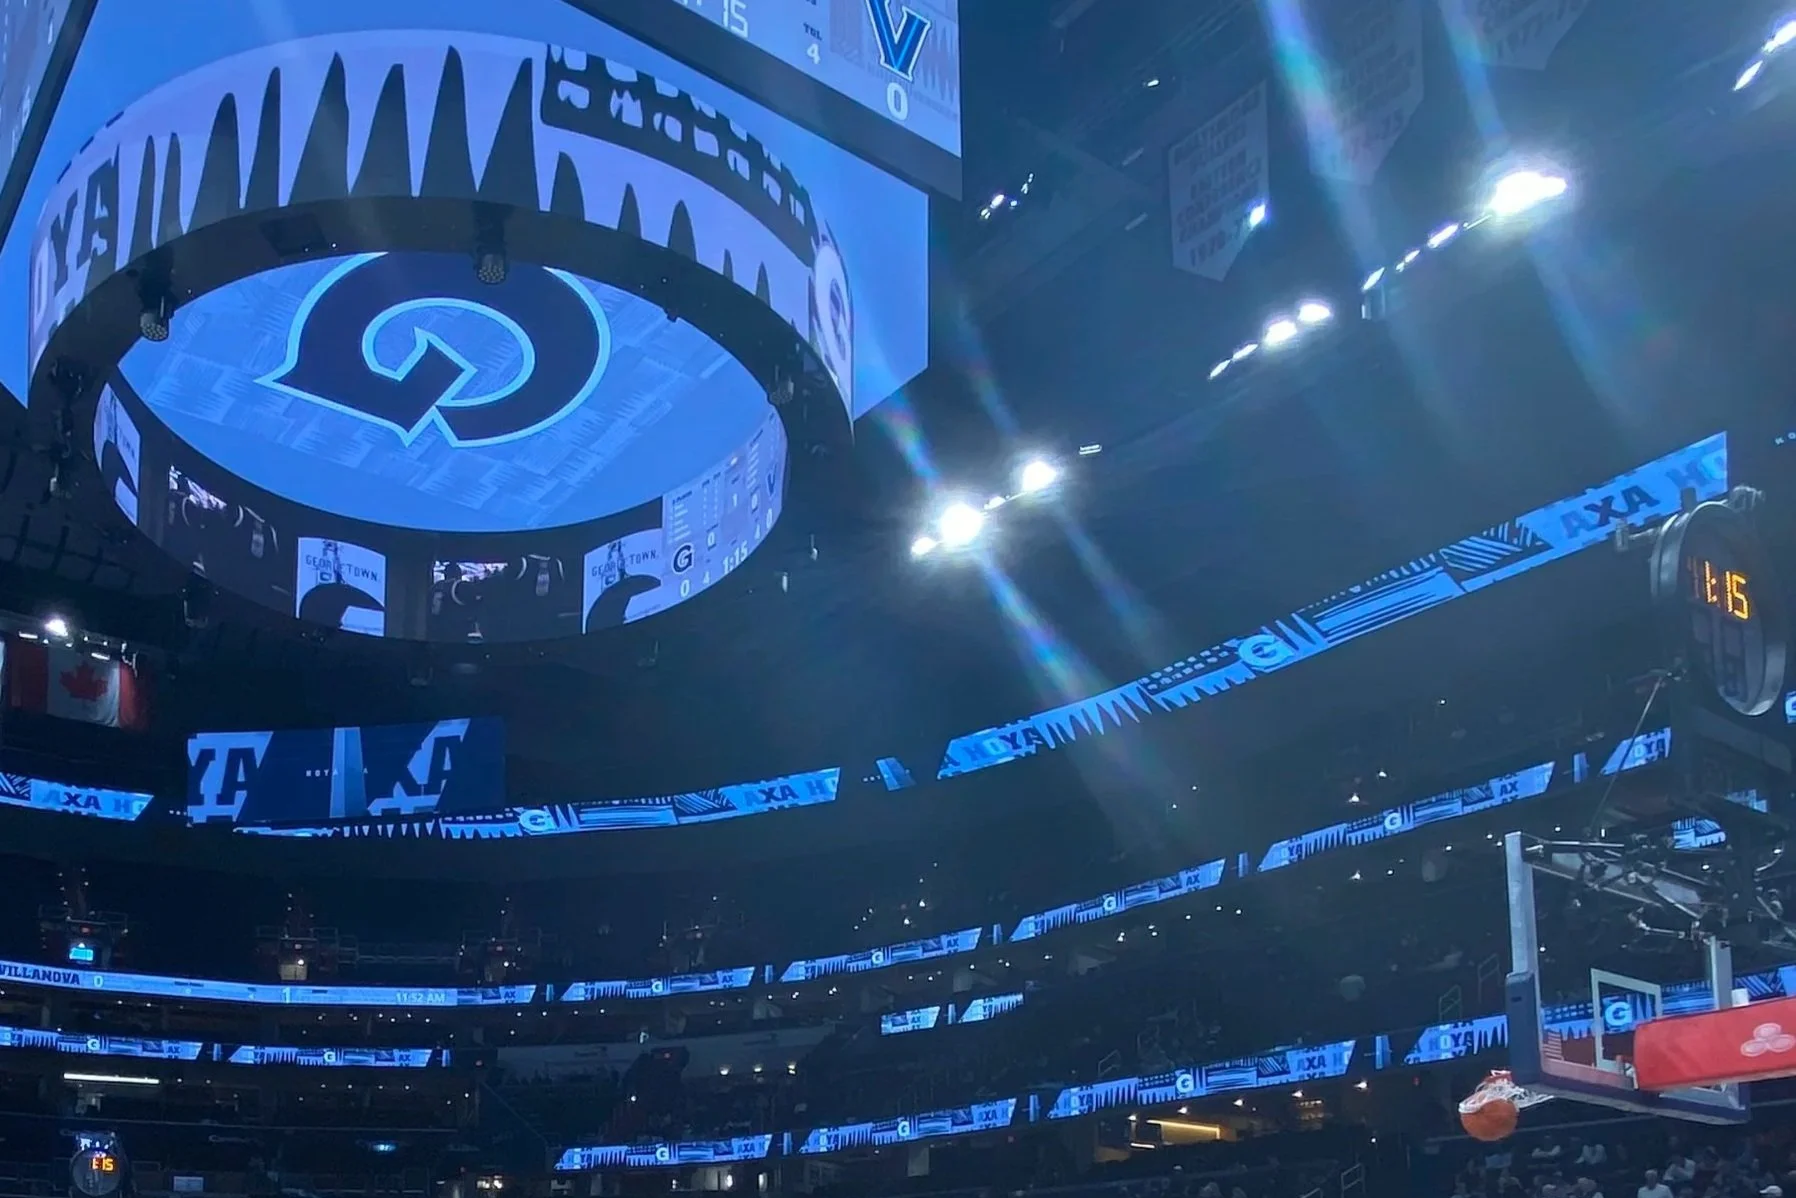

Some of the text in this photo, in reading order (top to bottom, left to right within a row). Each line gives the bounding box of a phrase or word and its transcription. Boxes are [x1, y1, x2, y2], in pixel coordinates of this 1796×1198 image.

[806, 43, 821, 64] 4
[886, 82, 908, 121] 0
[674, 544, 692, 573] G
[1605, 1001, 1632, 1026] G
[1176, 1074, 1194, 1092] G
